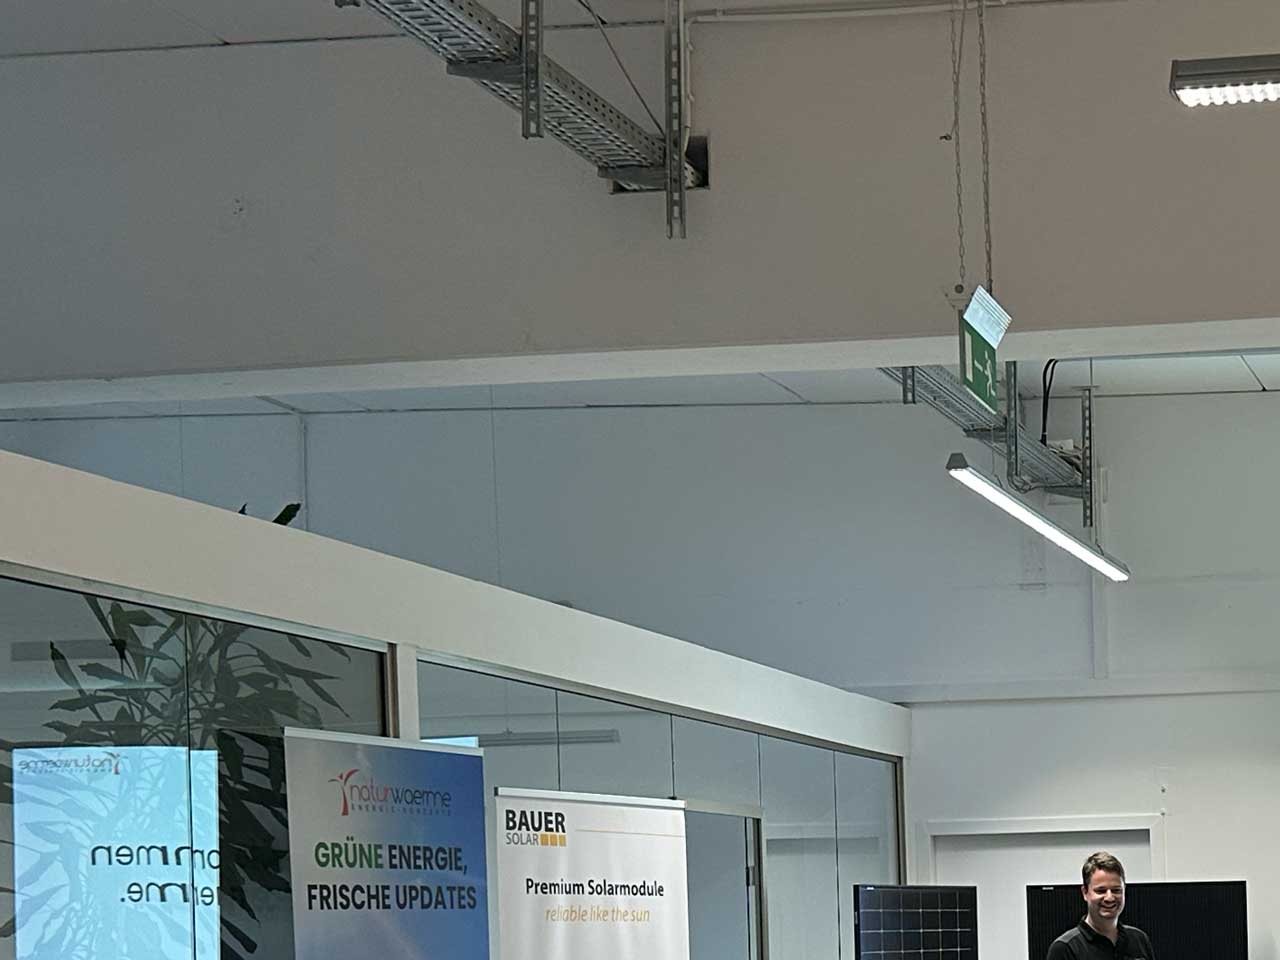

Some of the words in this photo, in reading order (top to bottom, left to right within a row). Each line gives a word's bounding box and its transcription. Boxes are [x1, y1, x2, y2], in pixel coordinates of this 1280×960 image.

[505, 808, 566, 833] BAUER
[505, 832, 539, 846] SOLAR
[315, 836, 383, 869] GRÜNE
[388, 845, 468, 875] ENERGIE,
[307, 883, 393, 911] FRISCHE
[396, 884, 477, 910] UPDATES
[526, 877, 585, 897] Premium
[587, 879, 664, 898] Solarmodule
[545, 905, 587, 922] reliable
[590, 906, 609, 922] like
[611, 906, 629, 922] the
[630, 909, 651, 922] sun
